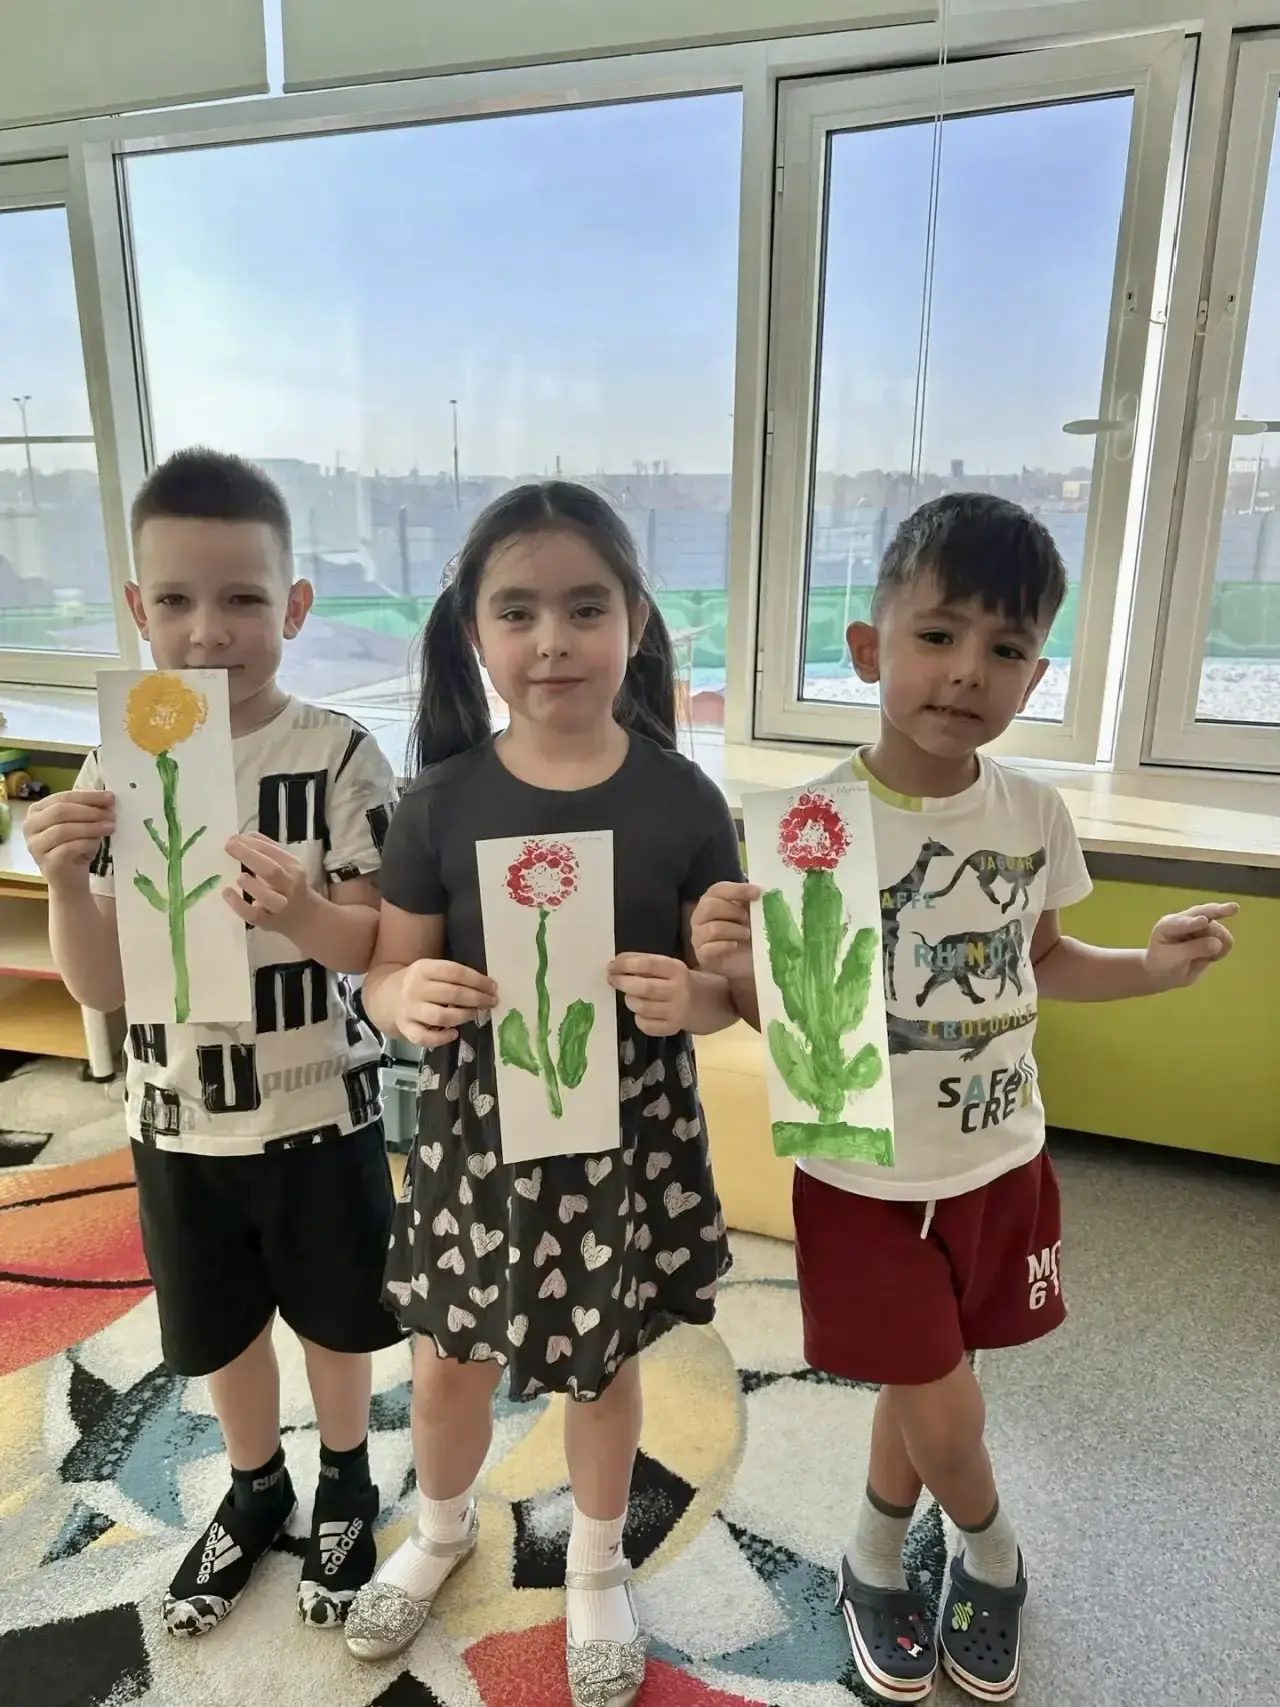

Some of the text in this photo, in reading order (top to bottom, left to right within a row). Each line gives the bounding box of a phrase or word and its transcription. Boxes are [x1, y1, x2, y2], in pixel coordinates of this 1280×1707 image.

[979, 855, 1034, 871] JAGUAR
[914, 941, 1002, 968] RHINO
[262, 1053, 349, 1099] PUMA
[196, 1522, 219, 1585] adidas
[323, 1516, 364, 1576] adidas
